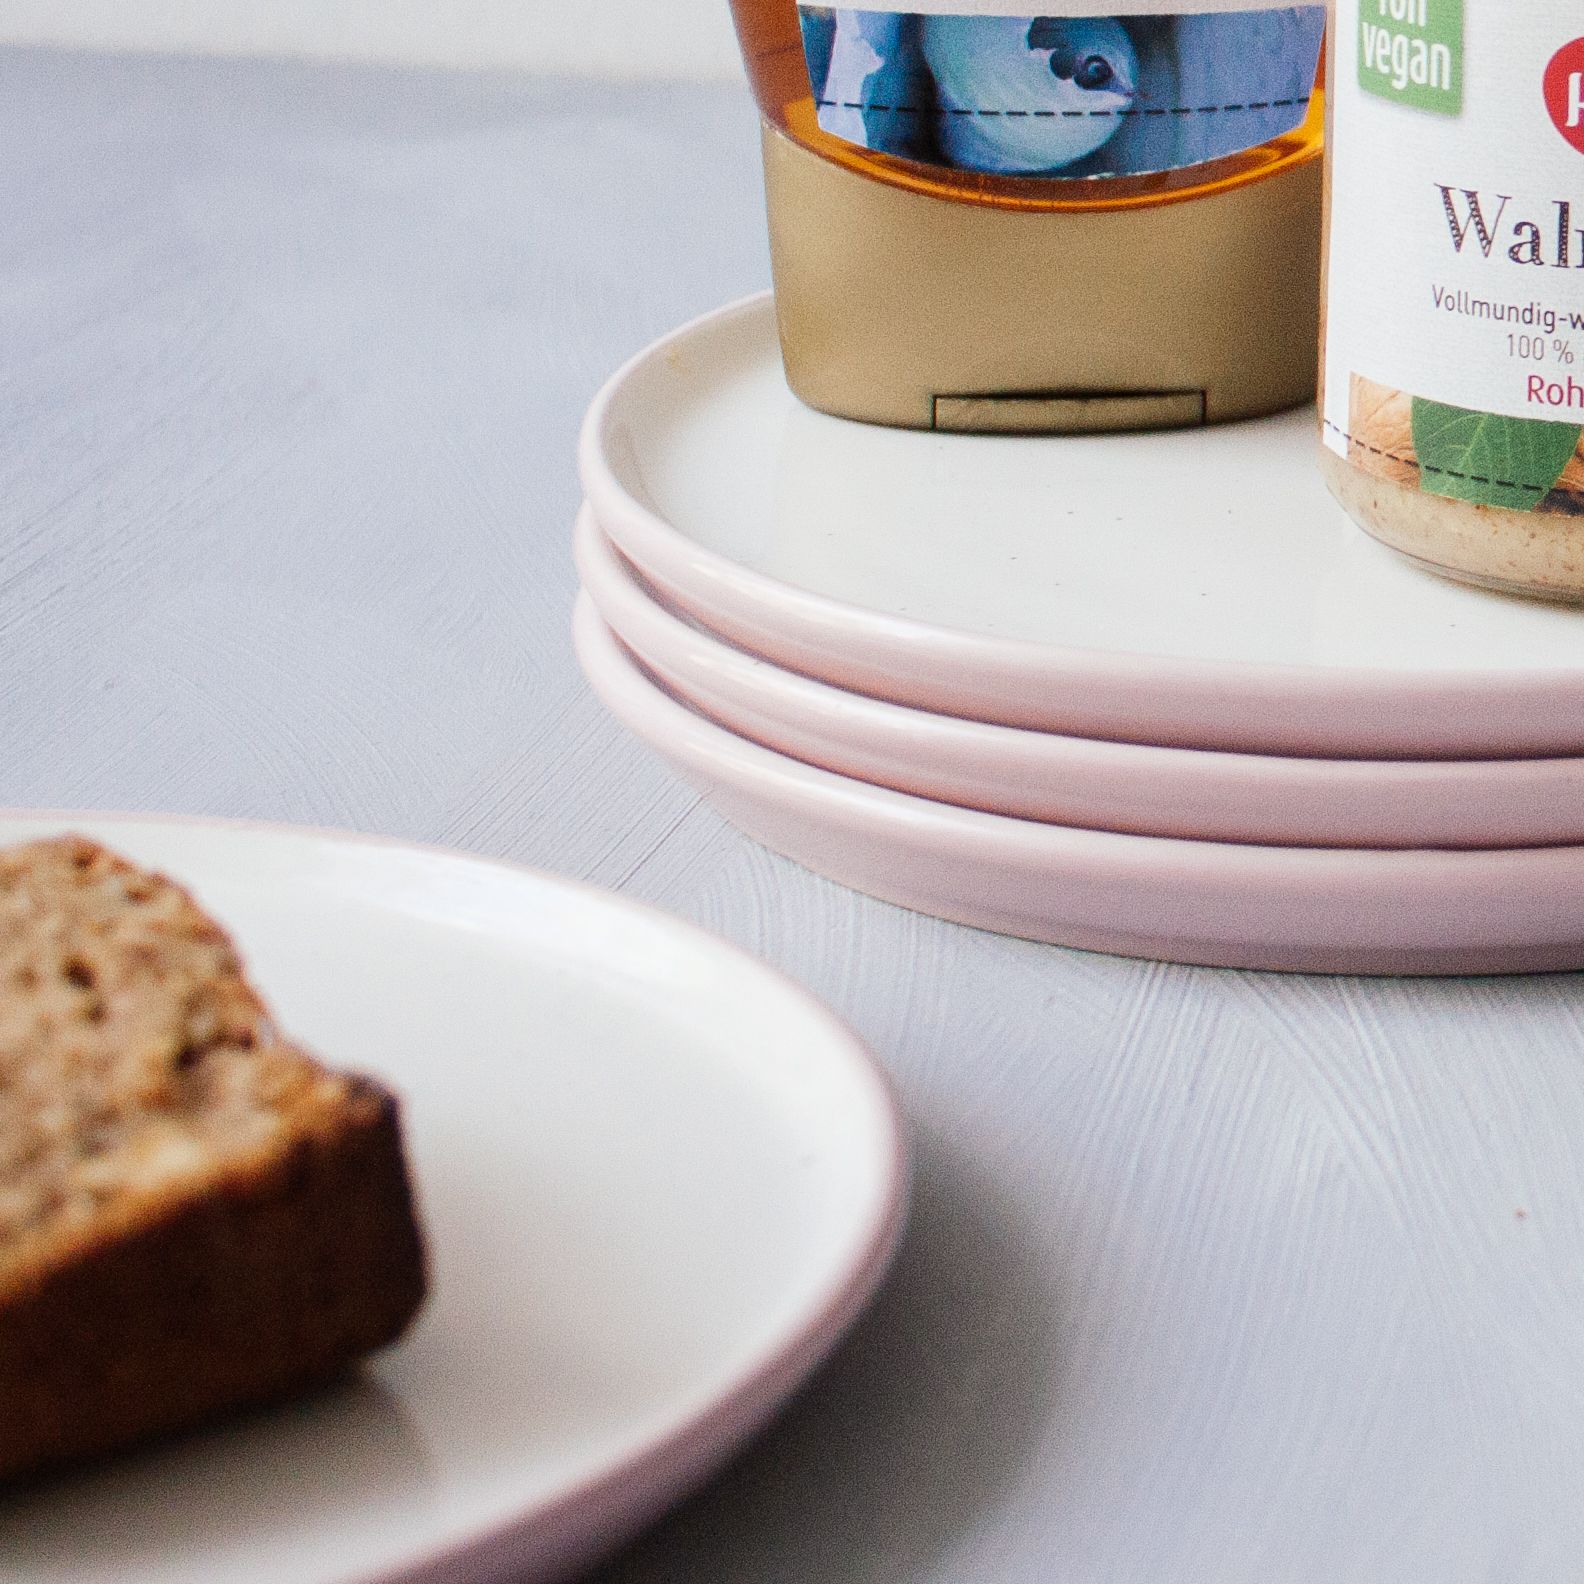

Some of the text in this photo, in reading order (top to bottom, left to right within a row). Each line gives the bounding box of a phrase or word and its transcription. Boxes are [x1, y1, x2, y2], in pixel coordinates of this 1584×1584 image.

[1361, 21, 1451, 91] vegan
[1506, 333, 1545, 361] 100
[1553, 339, 1574, 365] %
[1526, 375, 1584, 408] Roh
